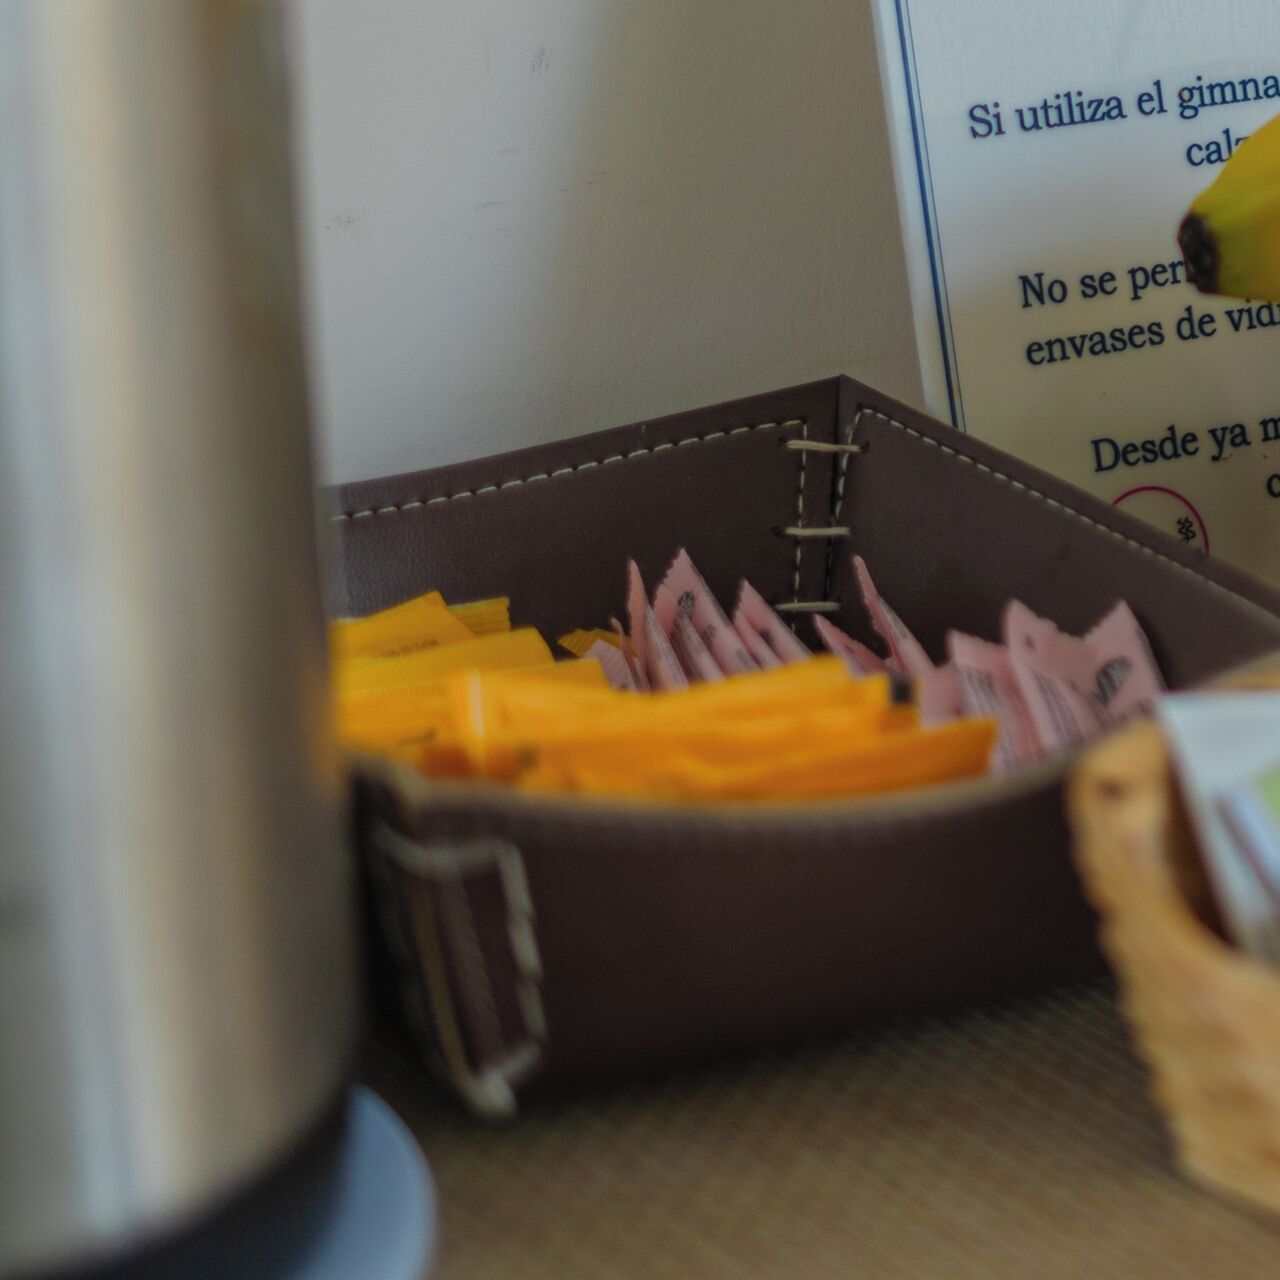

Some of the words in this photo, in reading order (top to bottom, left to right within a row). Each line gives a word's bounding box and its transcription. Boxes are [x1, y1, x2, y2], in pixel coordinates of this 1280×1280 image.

[969, 102, 1005, 138] Si
[1015, 91, 1127, 131] utiliza
[1137, 80, 1167, 115] el
[1186, 128, 1251, 166] cal
[1018, 273, 1067, 308] No
[1080, 272, 1117, 298] se
[1026, 322, 1164, 365] envases
[1177, 305, 1216, 340] de
[1091, 425, 1199, 472] Desde
[1208, 424, 1251, 462] ya
